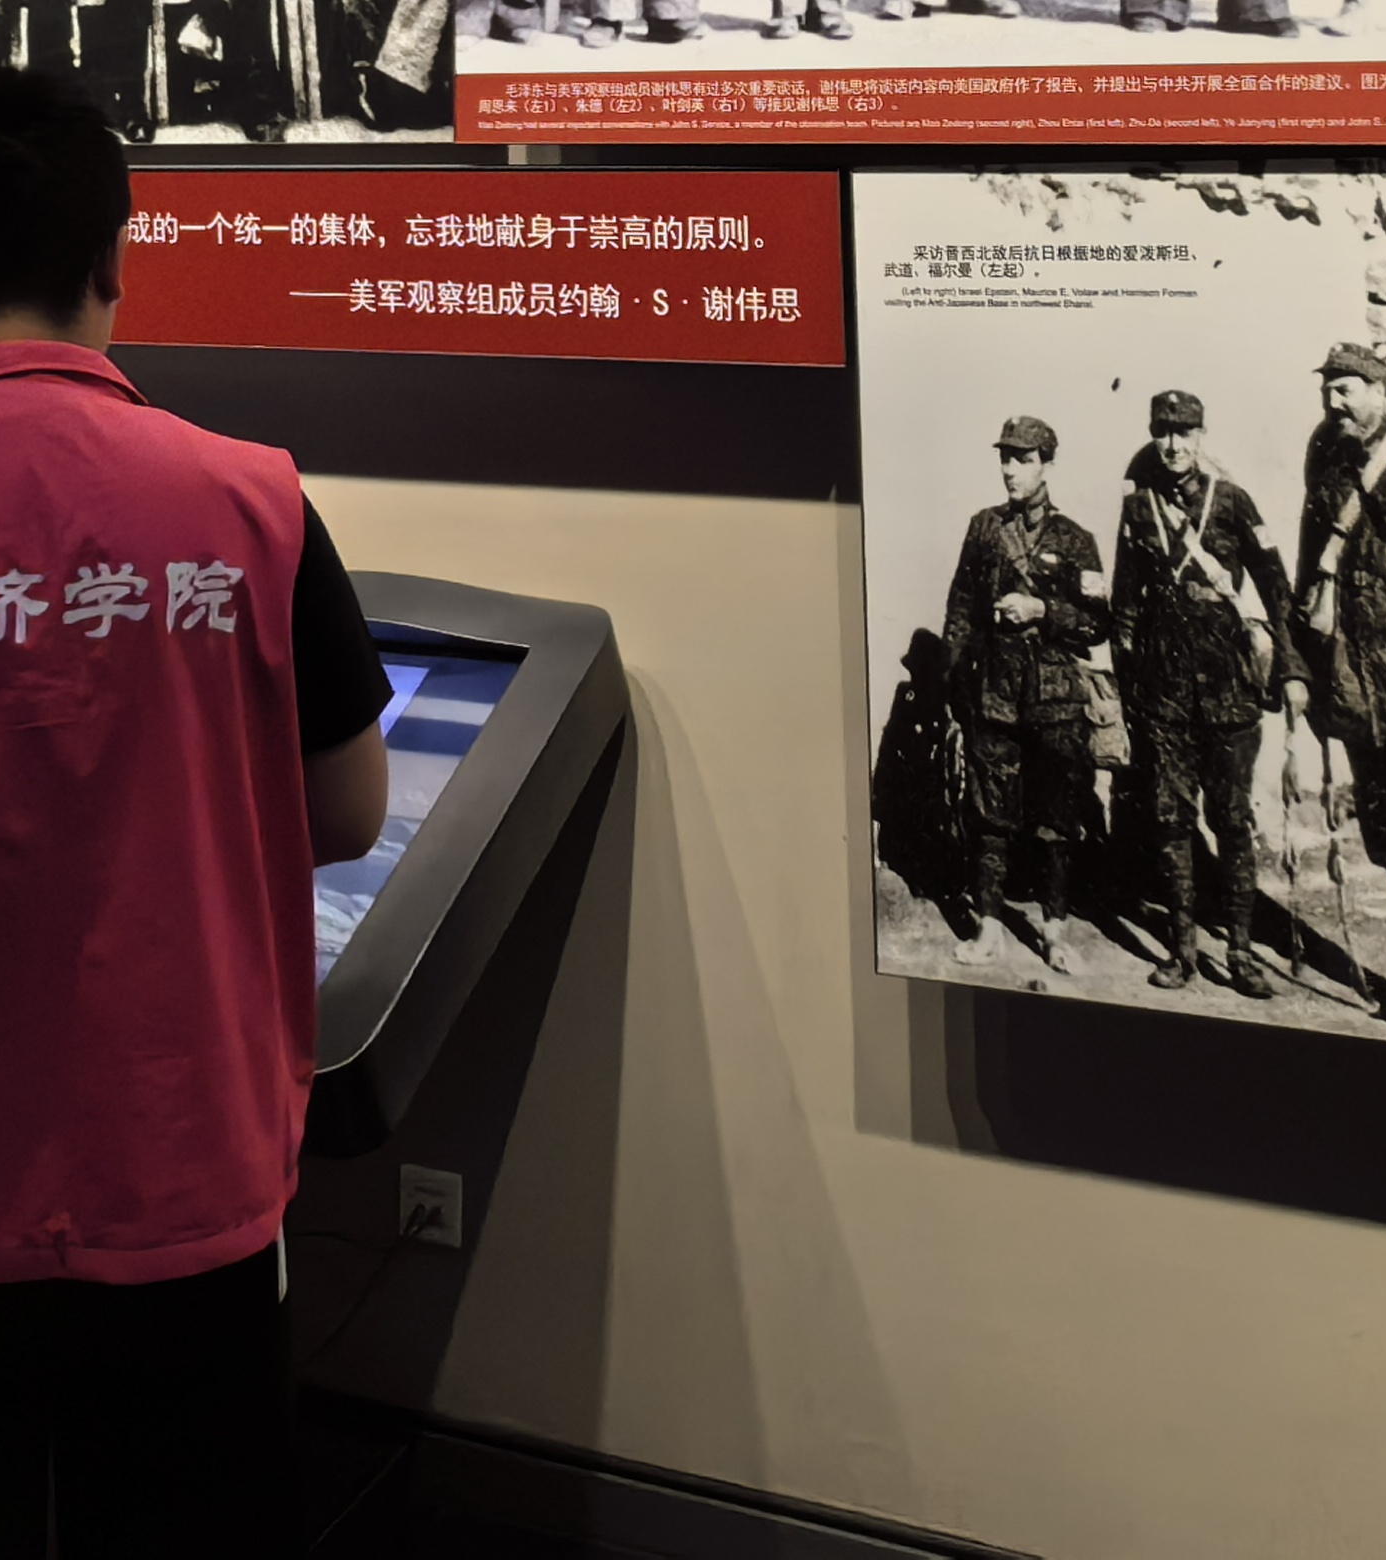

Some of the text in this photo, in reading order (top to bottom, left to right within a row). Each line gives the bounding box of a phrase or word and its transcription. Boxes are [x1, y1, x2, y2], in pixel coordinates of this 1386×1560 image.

[913, 245, 1197, 261] 采访晋西北敌后抗日根据地的爱泼斯坦、
[884, 263, 1040, 278] 武道、福尔曼（左起）。
